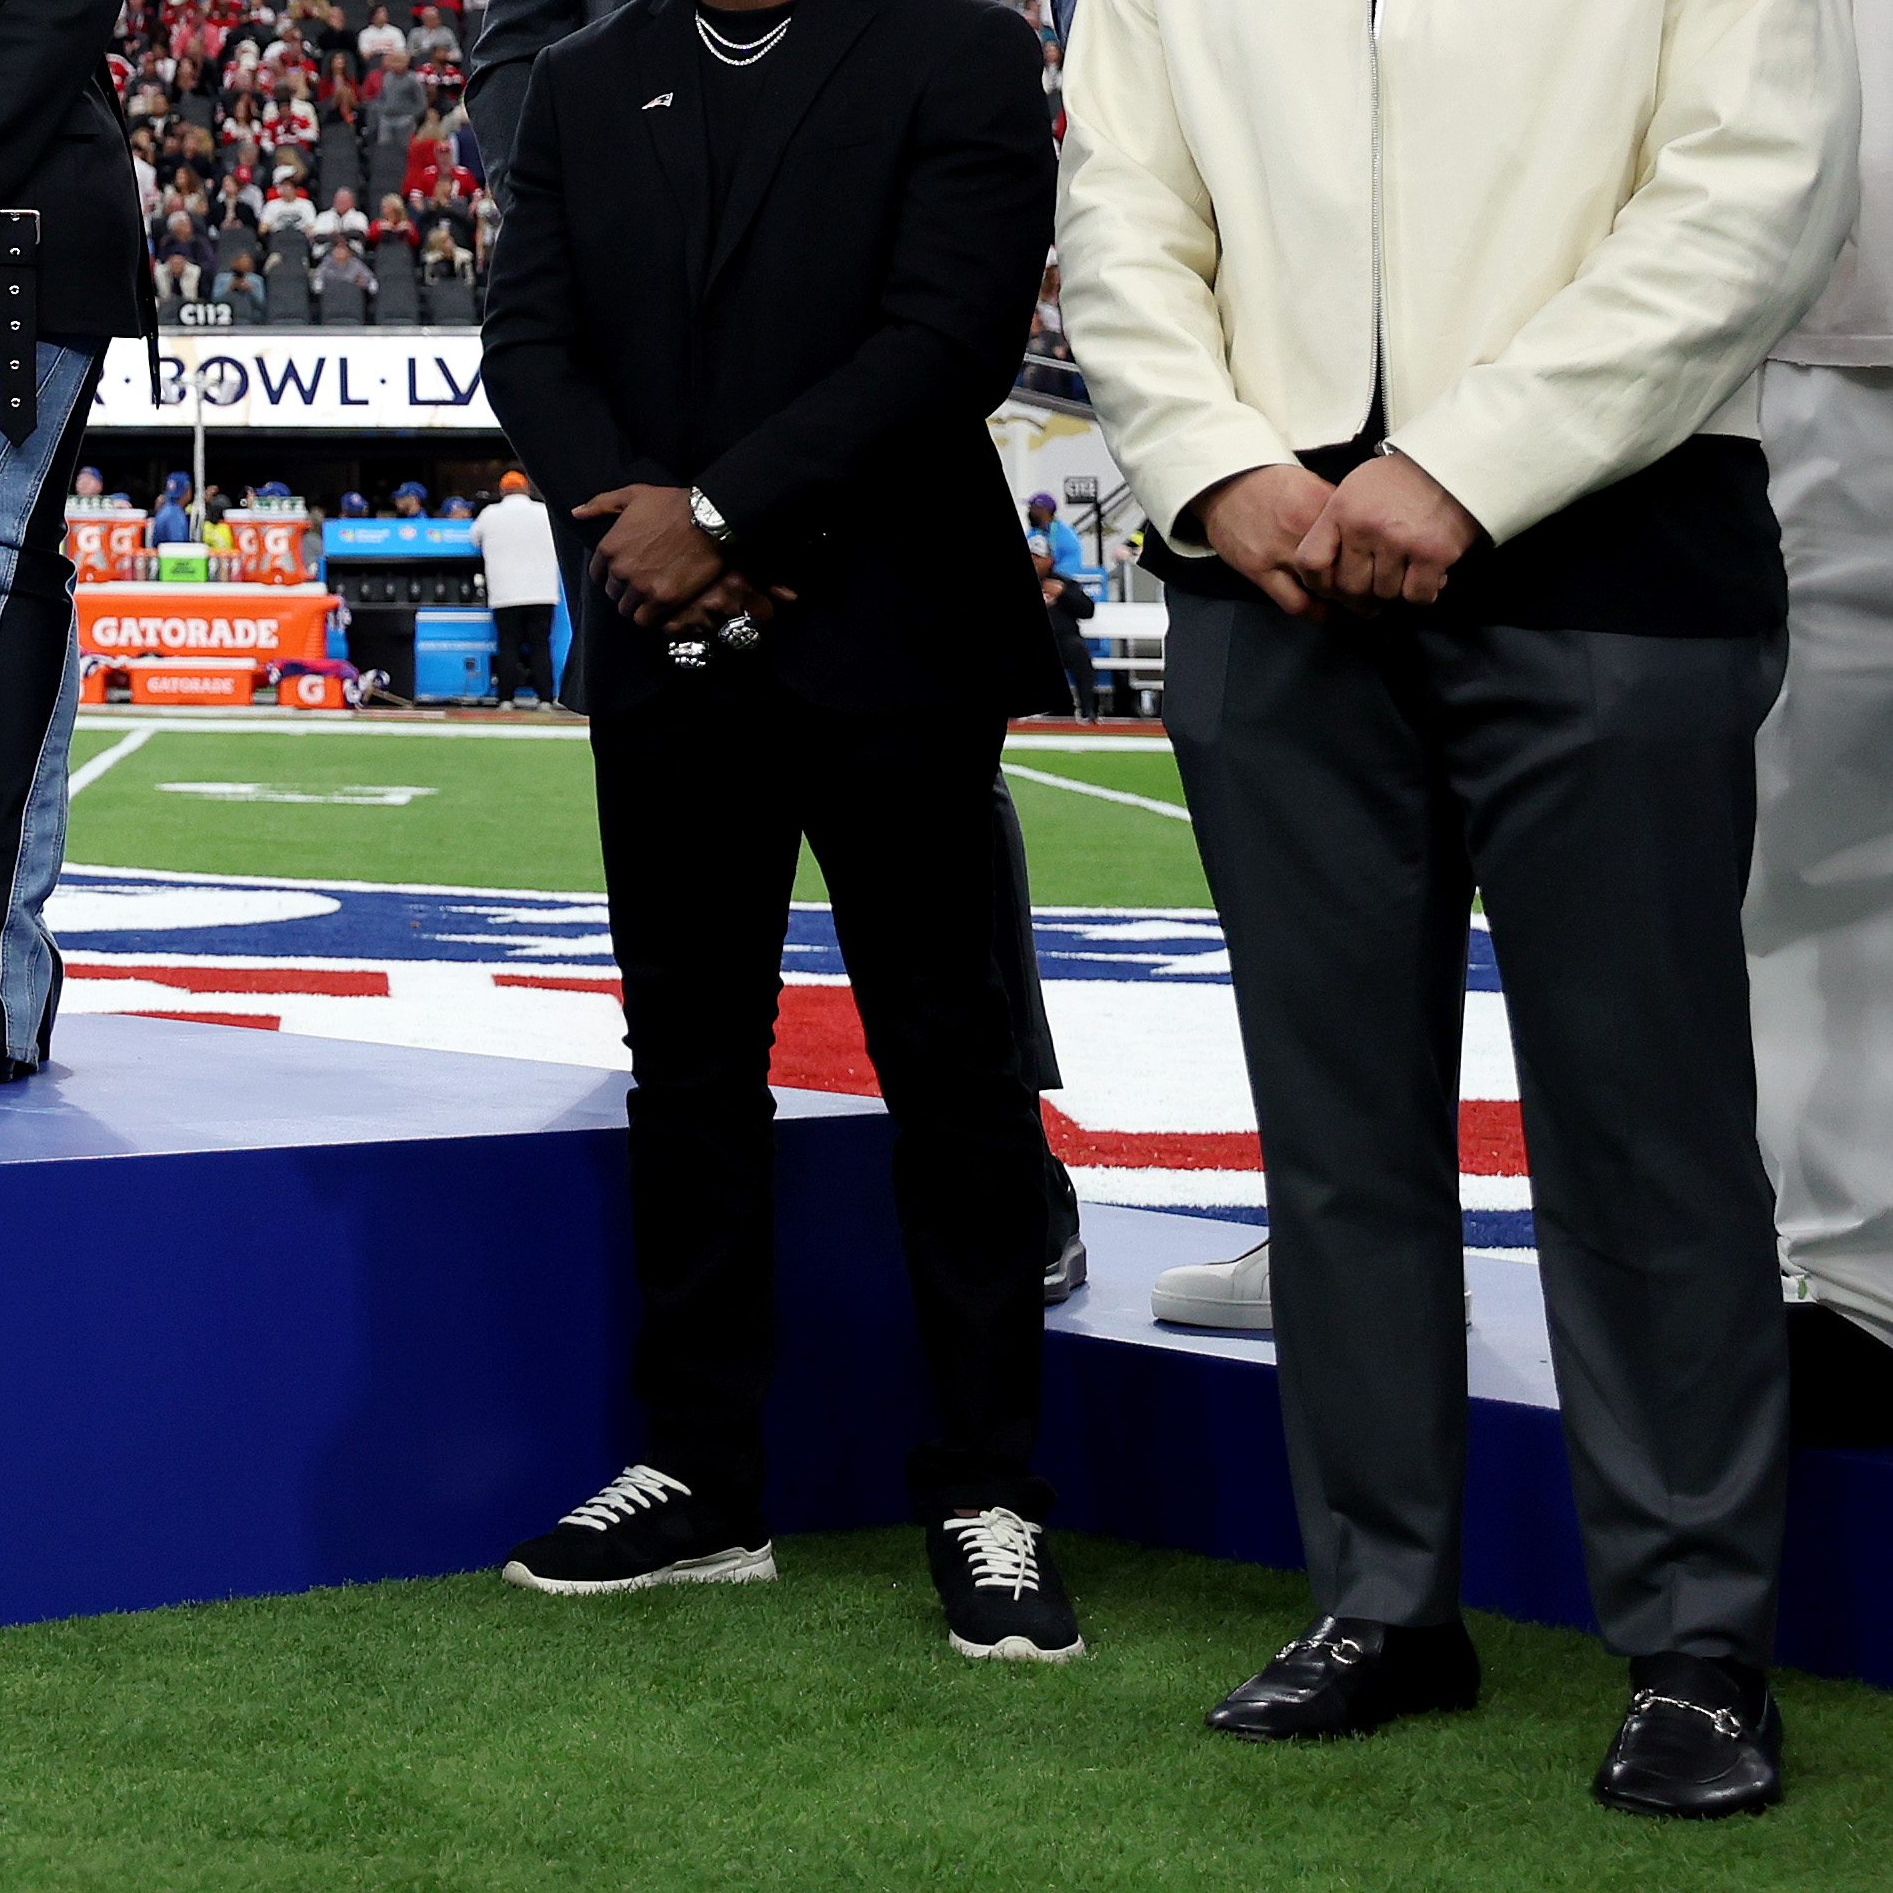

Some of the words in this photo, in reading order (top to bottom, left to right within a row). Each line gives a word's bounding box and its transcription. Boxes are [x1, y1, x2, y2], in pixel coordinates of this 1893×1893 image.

[179, 303, 234, 326] C112
[151, 355, 369, 406] BOWL
[92, 616, 279, 648] GATORADE
[146, 676, 234, 694] GATORADE
[296, 674, 326, 703] G
